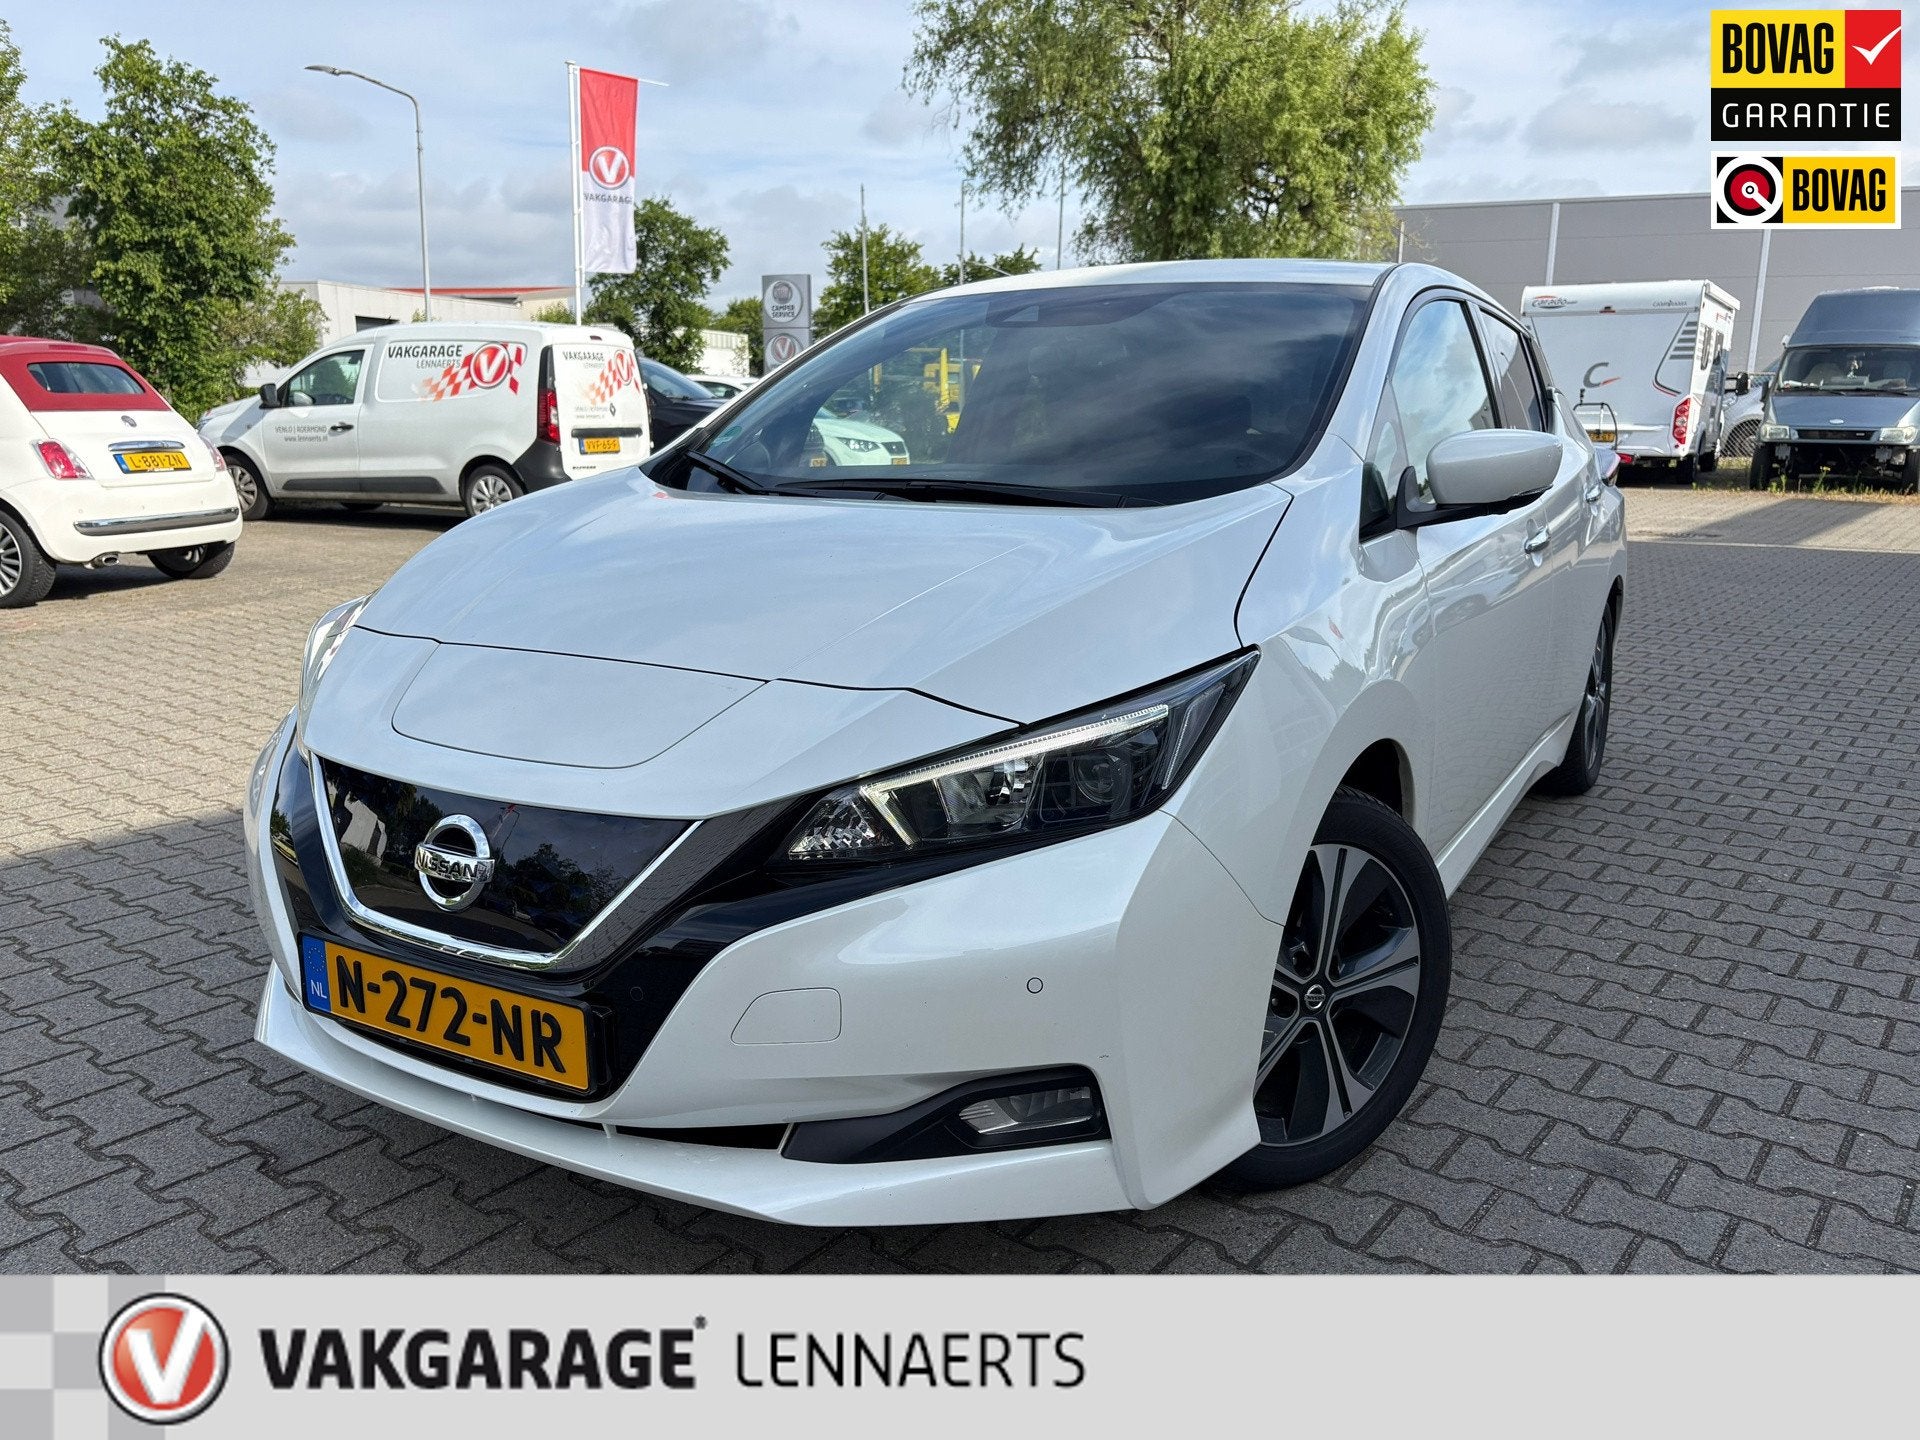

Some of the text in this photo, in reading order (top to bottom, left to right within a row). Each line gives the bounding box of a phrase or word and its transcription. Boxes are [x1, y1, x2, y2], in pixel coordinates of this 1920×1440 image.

[388, 344, 463, 358] VAKGARAGE
[416, 358, 462, 369] LENNAERTS
[416, 849, 479, 878] NISSAN
[310, 978, 328, 999] NL
[335, 955, 566, 1074] N-272-NR
